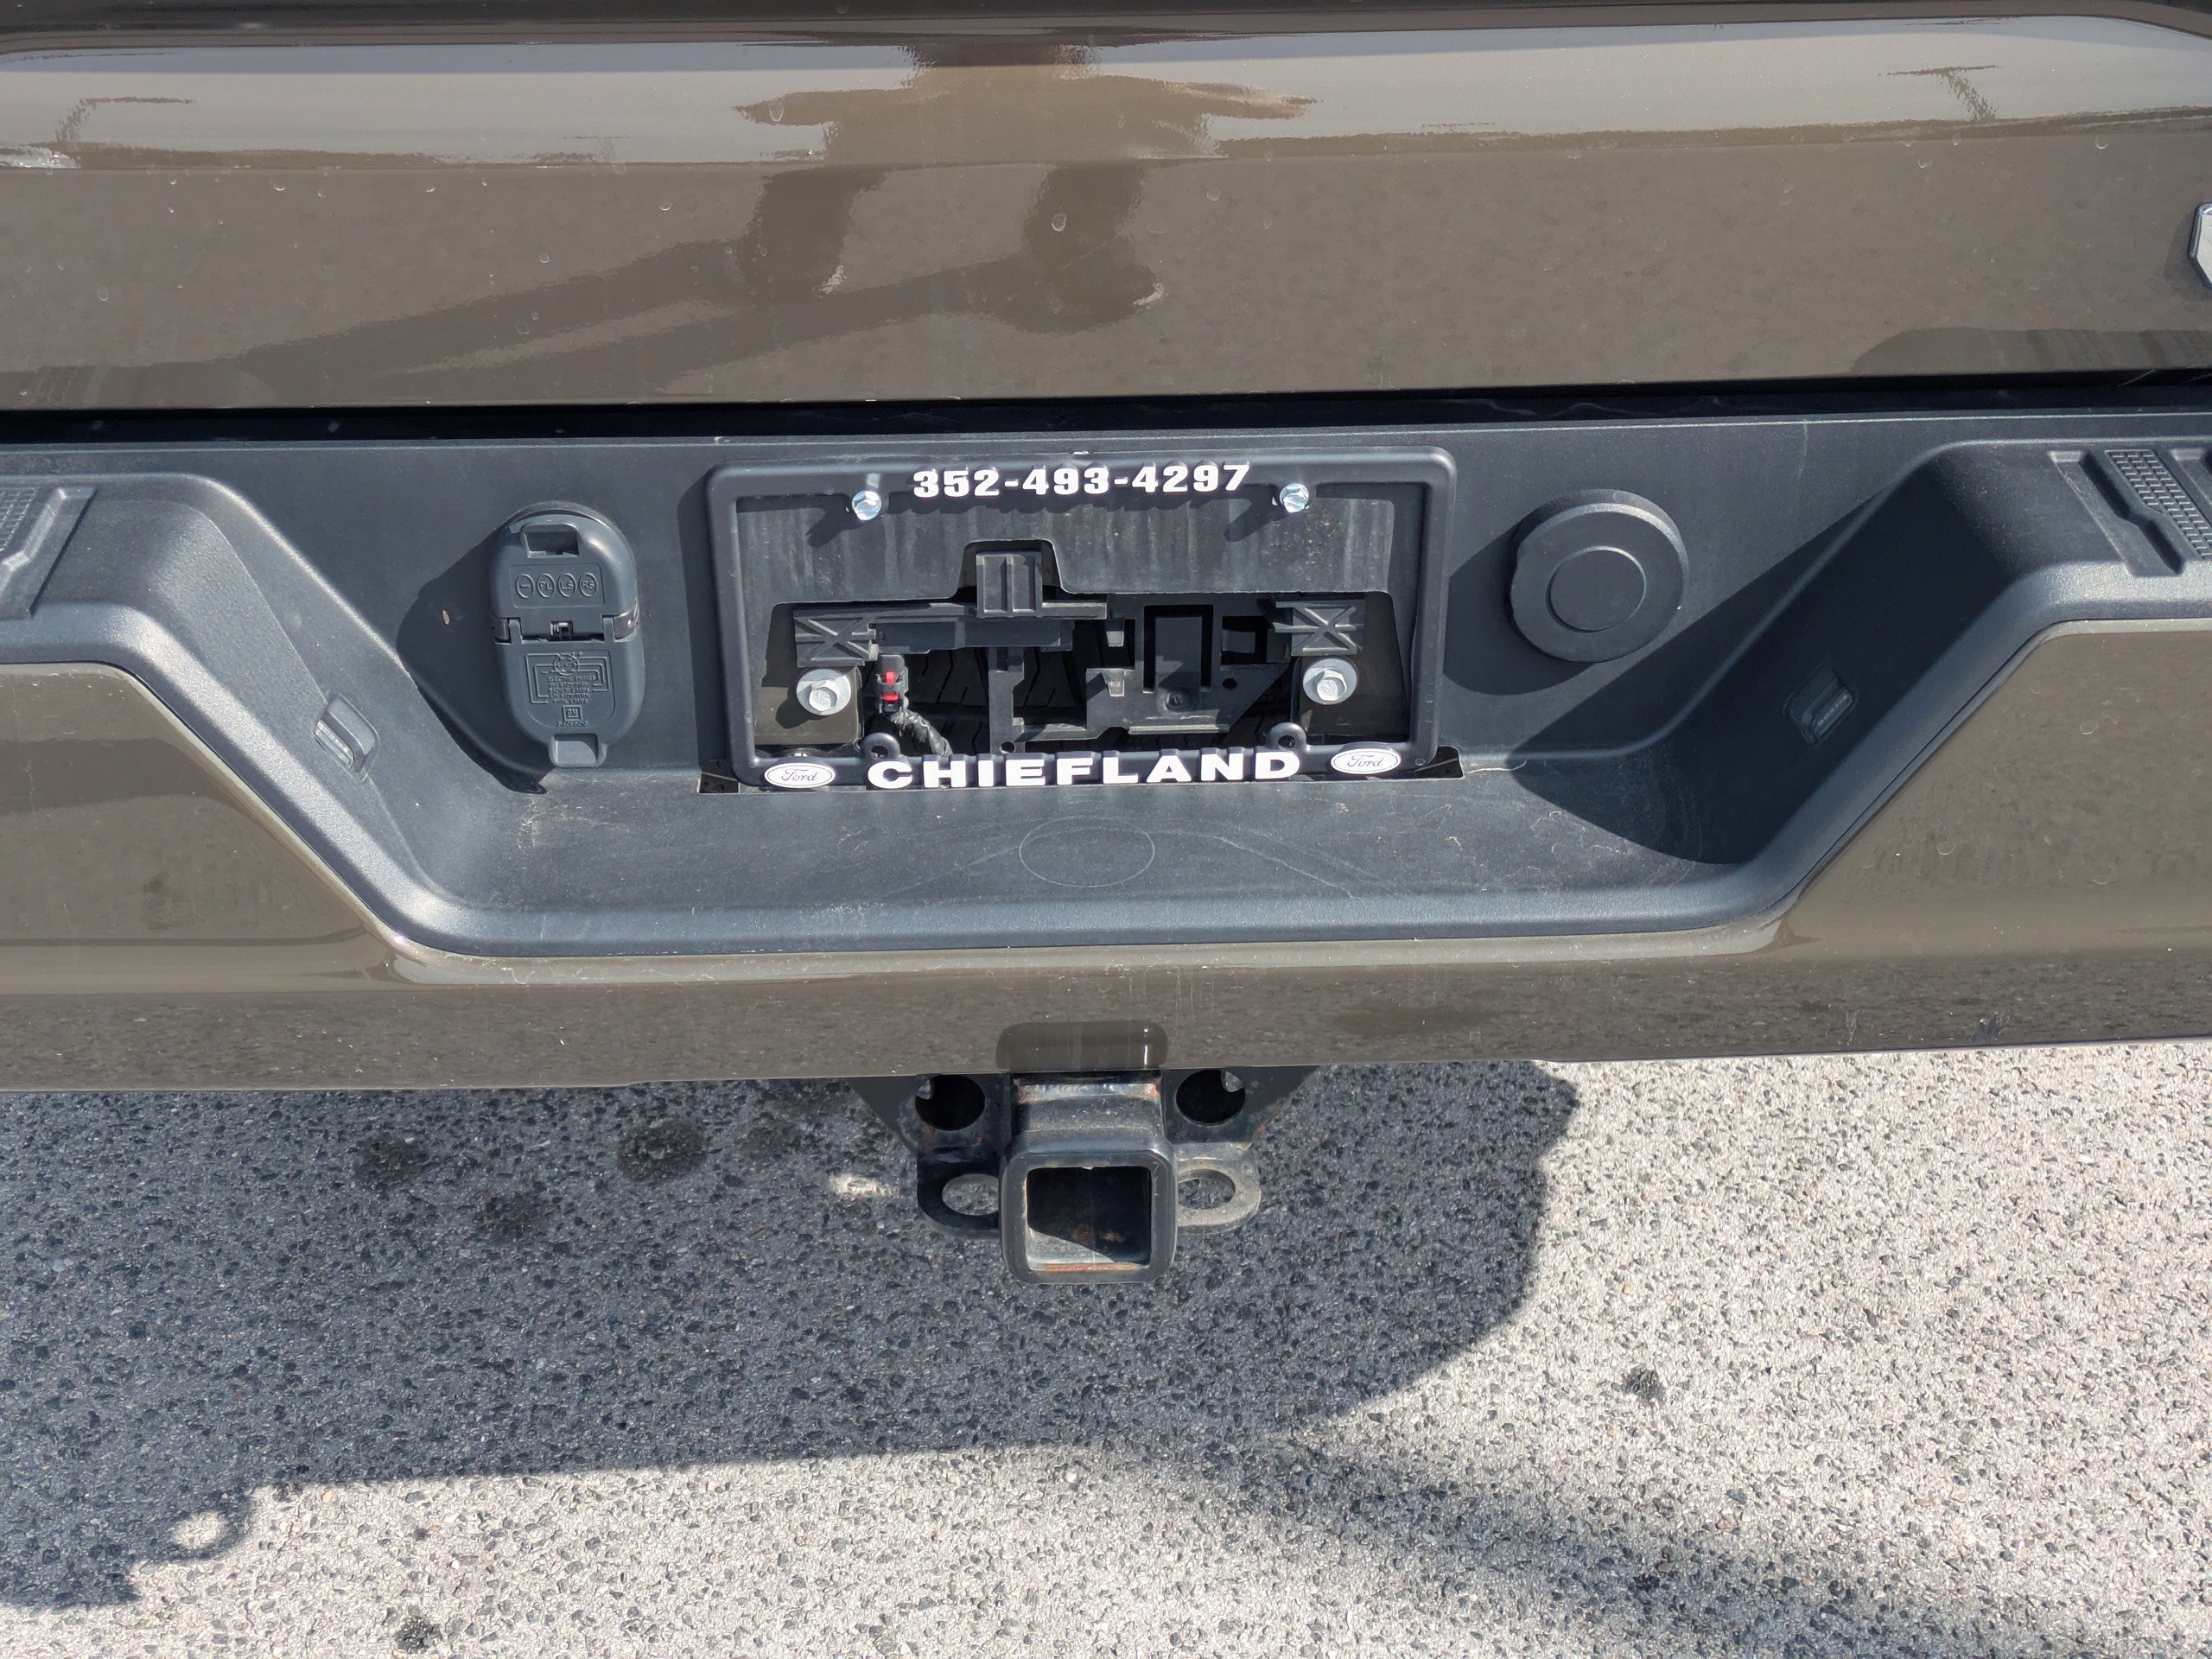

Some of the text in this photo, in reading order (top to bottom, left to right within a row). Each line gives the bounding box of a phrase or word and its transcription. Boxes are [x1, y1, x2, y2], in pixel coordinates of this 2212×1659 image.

[913, 465, 1250, 498] 352-493-4297
[560, 581, 574, 590] LS
[581, 580, 595, 590] RS
[1347, 754, 1384, 767] Ford
[781, 768, 818, 781] Ford
[868, 751, 1300, 790] CHIEFLAND
